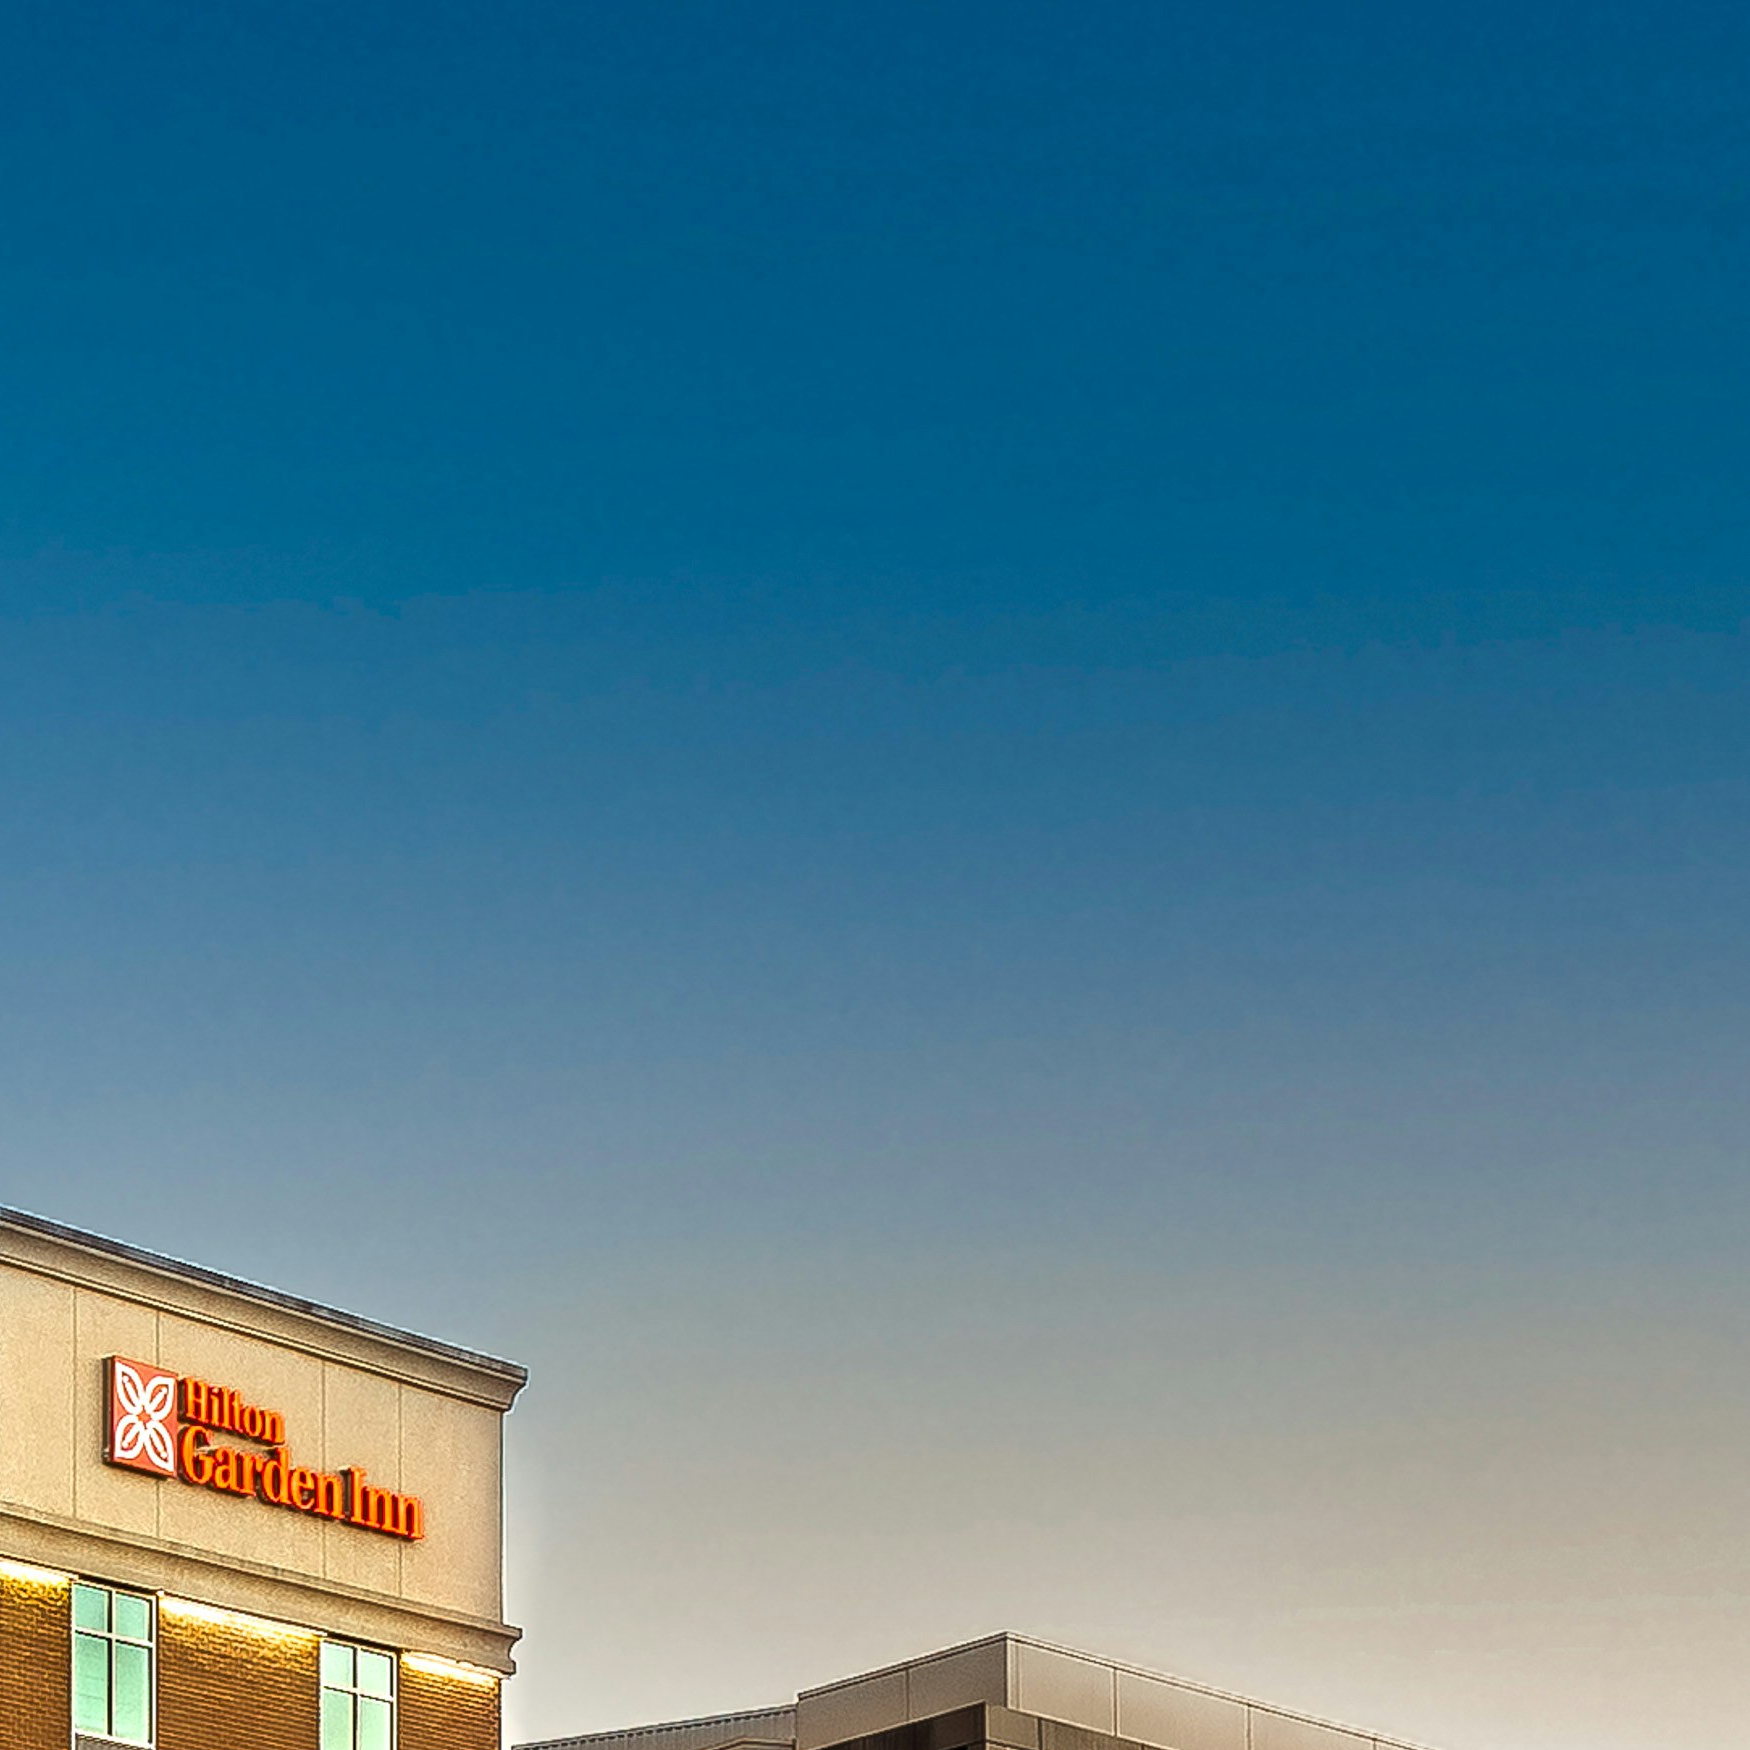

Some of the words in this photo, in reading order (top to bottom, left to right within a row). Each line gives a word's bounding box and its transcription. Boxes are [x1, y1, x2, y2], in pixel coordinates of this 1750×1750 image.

[184, 1377, 285, 1445] Hilton
[181, 1425, 345, 1520] Garden
[348, 1467, 425, 1541] Inn
